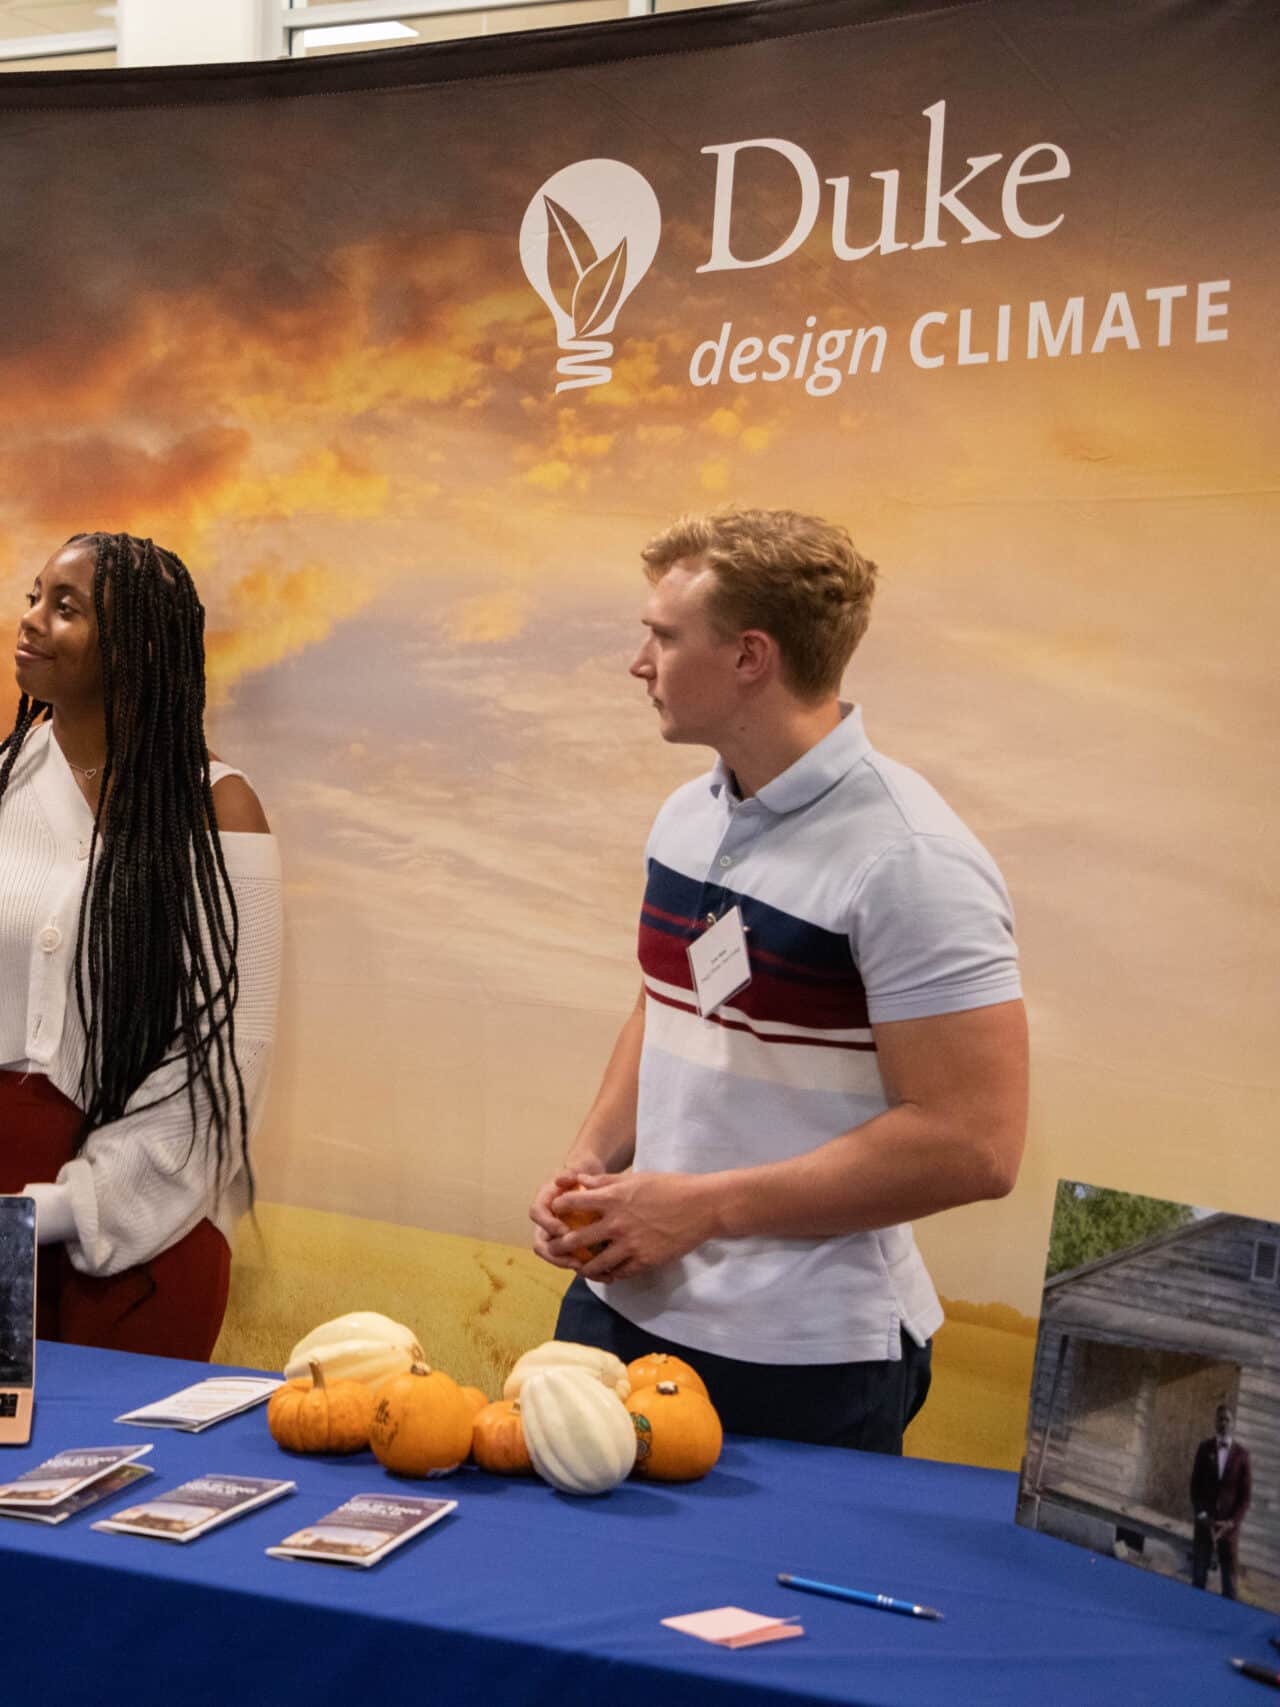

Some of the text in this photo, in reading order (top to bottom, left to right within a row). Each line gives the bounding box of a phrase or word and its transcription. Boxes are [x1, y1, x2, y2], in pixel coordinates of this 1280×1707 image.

[696, 99, 1071, 274] Duke
[688, 280, 1231, 397] design CLIMATE
